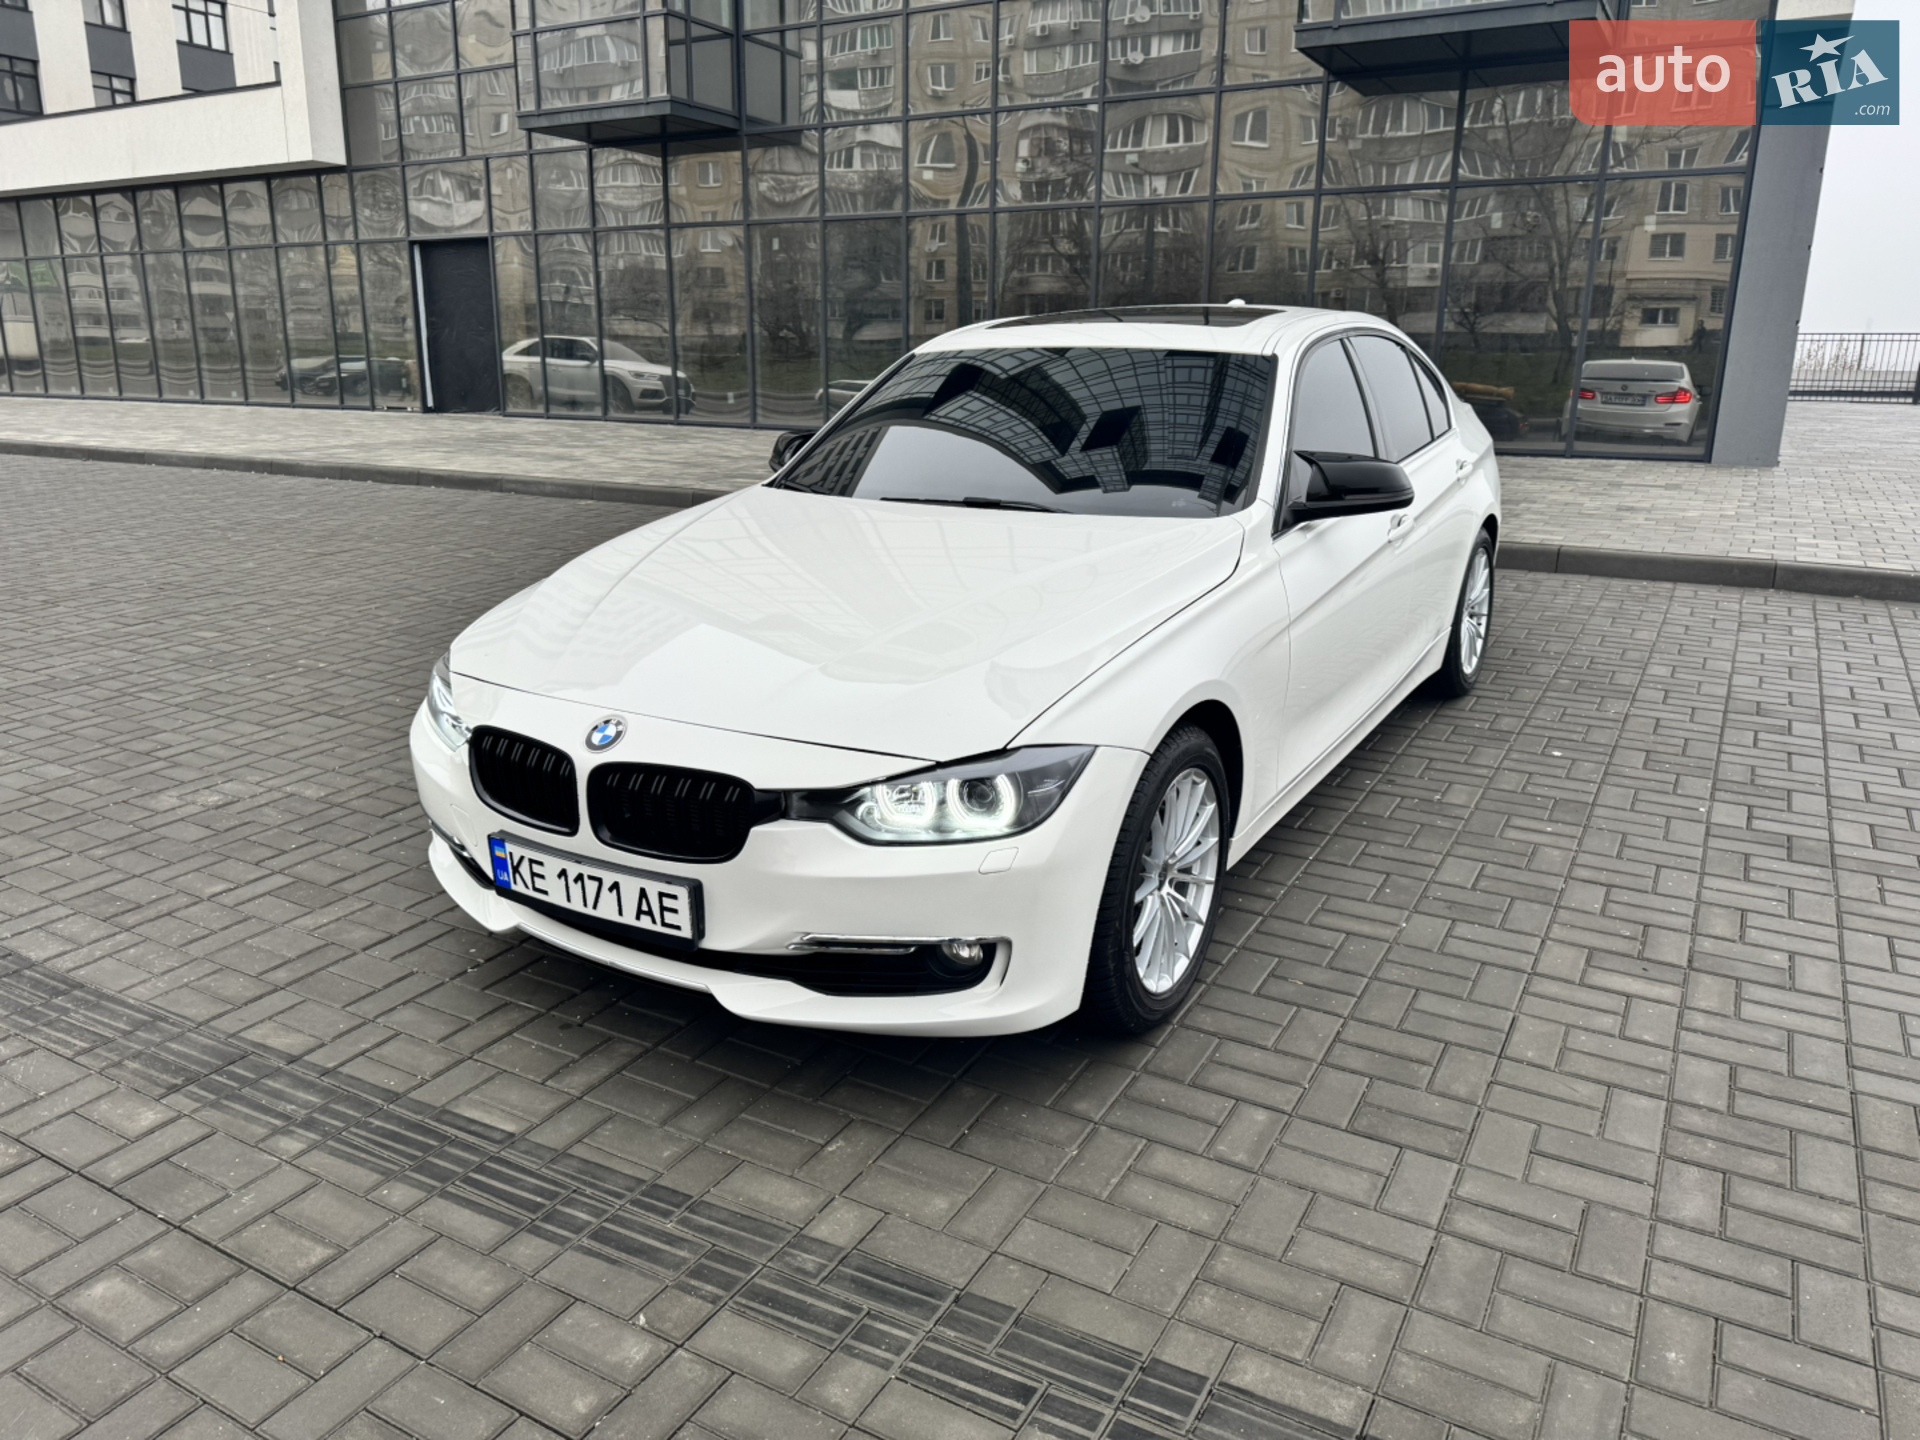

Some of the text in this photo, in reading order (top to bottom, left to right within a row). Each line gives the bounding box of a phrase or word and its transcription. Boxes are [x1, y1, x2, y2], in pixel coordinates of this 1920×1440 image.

[497, 869, 509, 882] UA
[508, 851, 682, 931] KE 1171 AE
